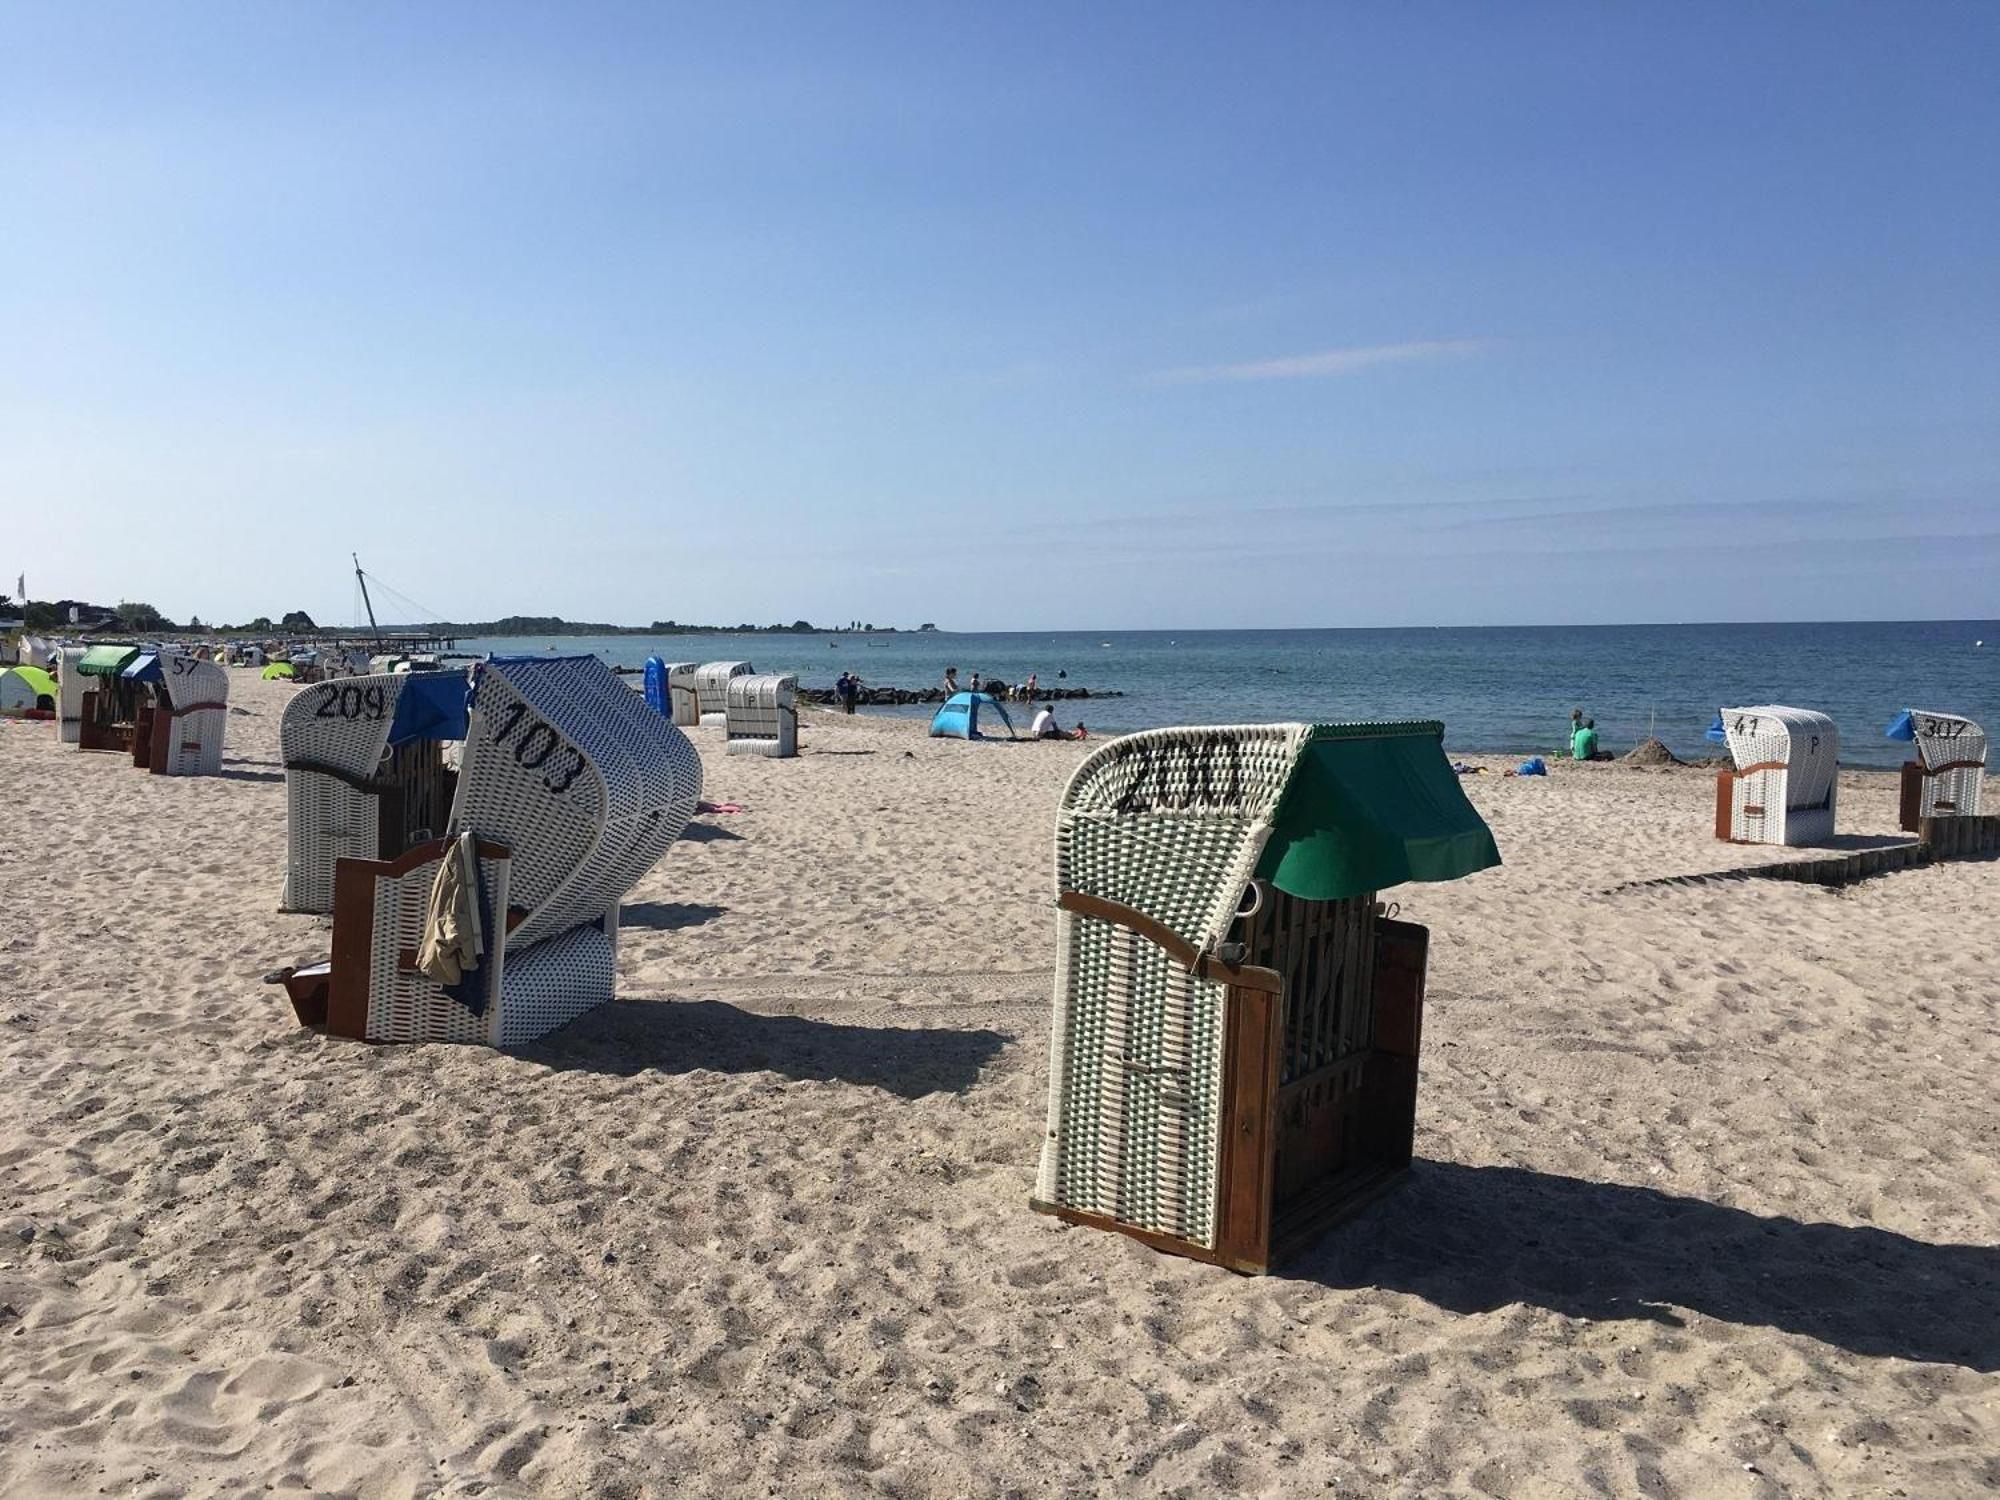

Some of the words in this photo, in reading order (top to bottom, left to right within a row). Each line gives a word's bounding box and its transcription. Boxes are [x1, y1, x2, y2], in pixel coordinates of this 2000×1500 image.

[173, 656, 200, 676] 57
[710, 678, 717, 688] P
[316, 684, 385, 721] 209
[748, 695, 756, 707] P
[1734, 716, 1758, 737] 41
[1923, 718, 1967, 741] 307
[493, 702, 586, 795] 103
[1811, 736, 1820, 755] P
